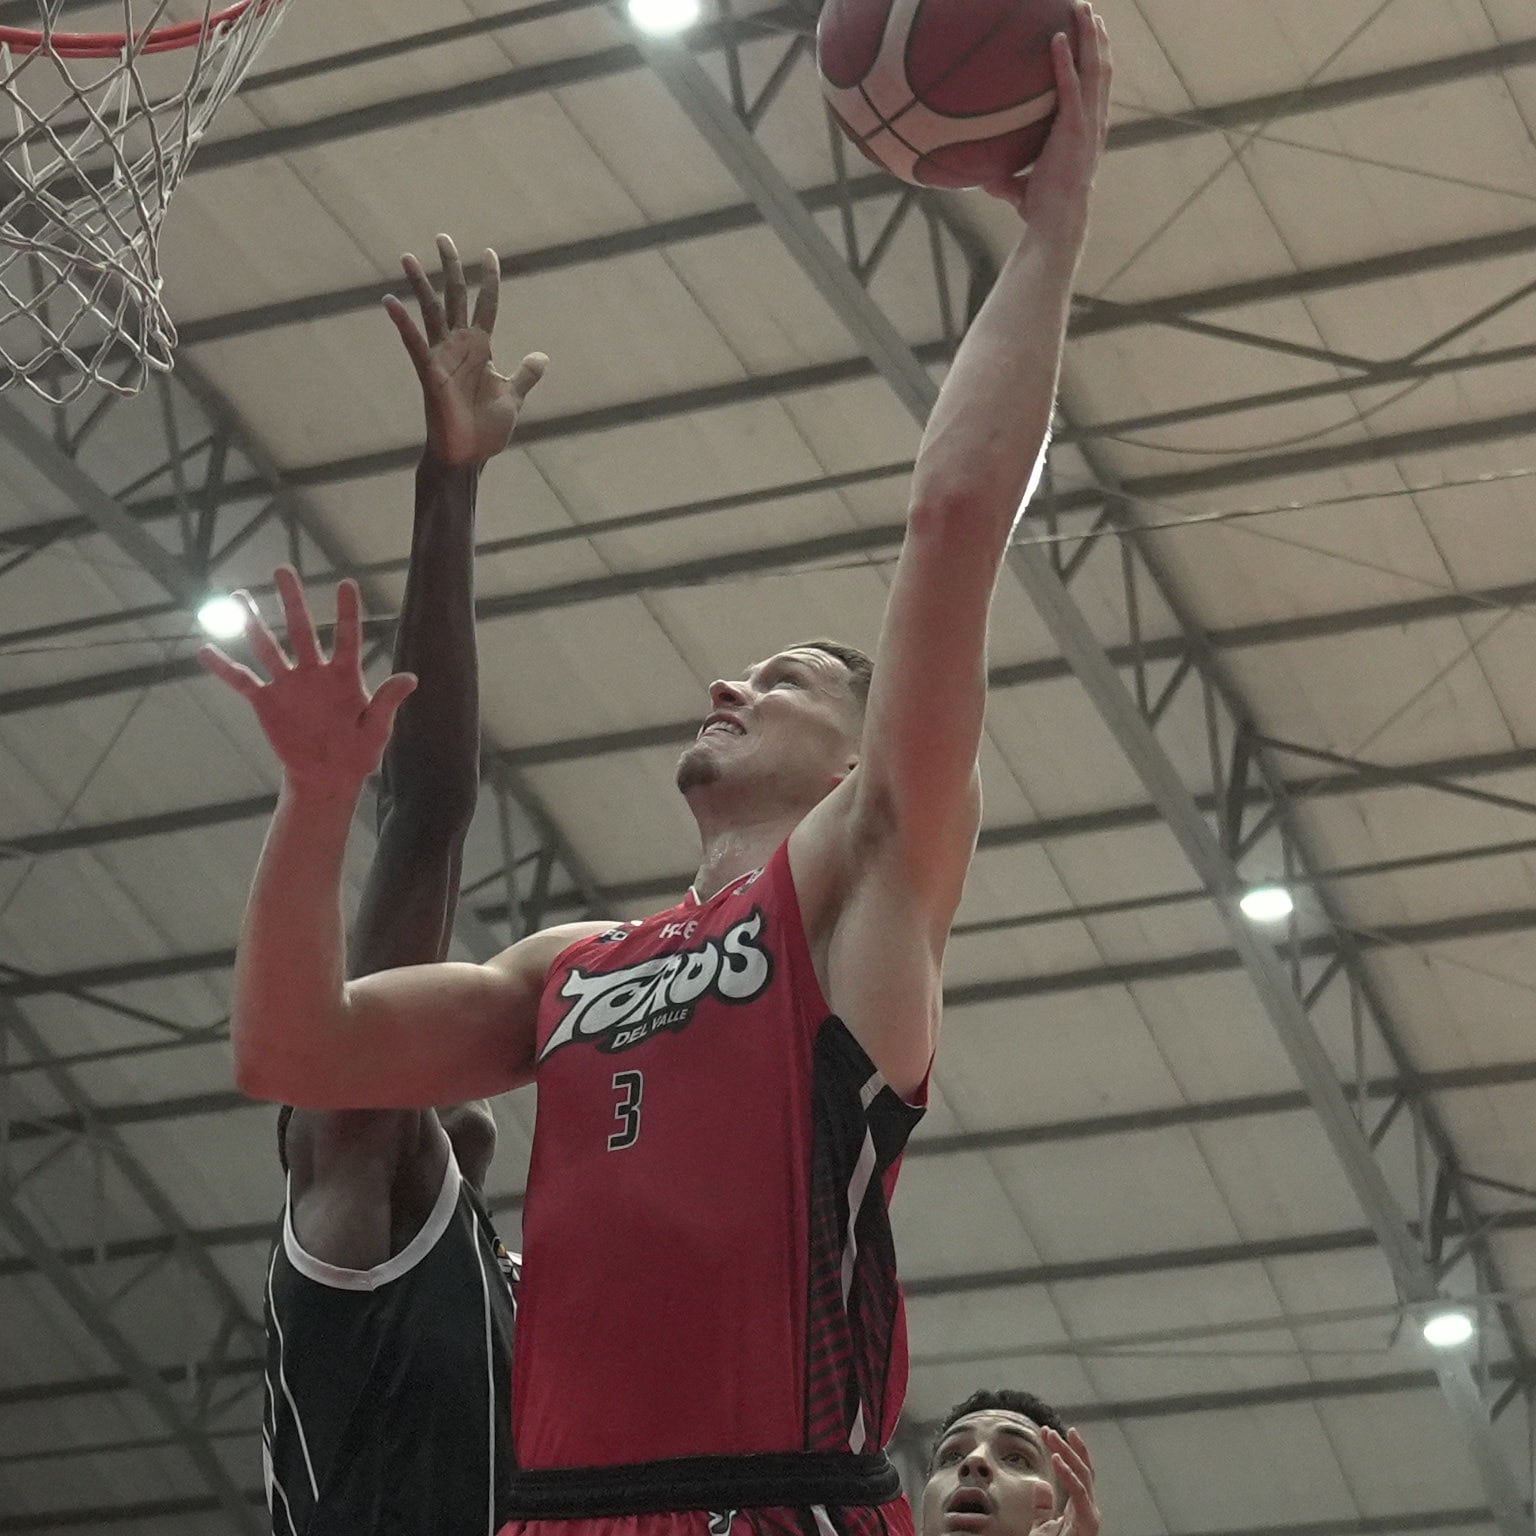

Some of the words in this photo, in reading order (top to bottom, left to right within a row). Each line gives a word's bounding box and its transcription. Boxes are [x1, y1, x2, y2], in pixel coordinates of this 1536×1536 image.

[539, 912, 768, 1060] TOROS
[611, 1027, 648, 1049] DEL
[651, 1008, 689, 1032] VALLE
[607, 1069, 644, 1152] 3
